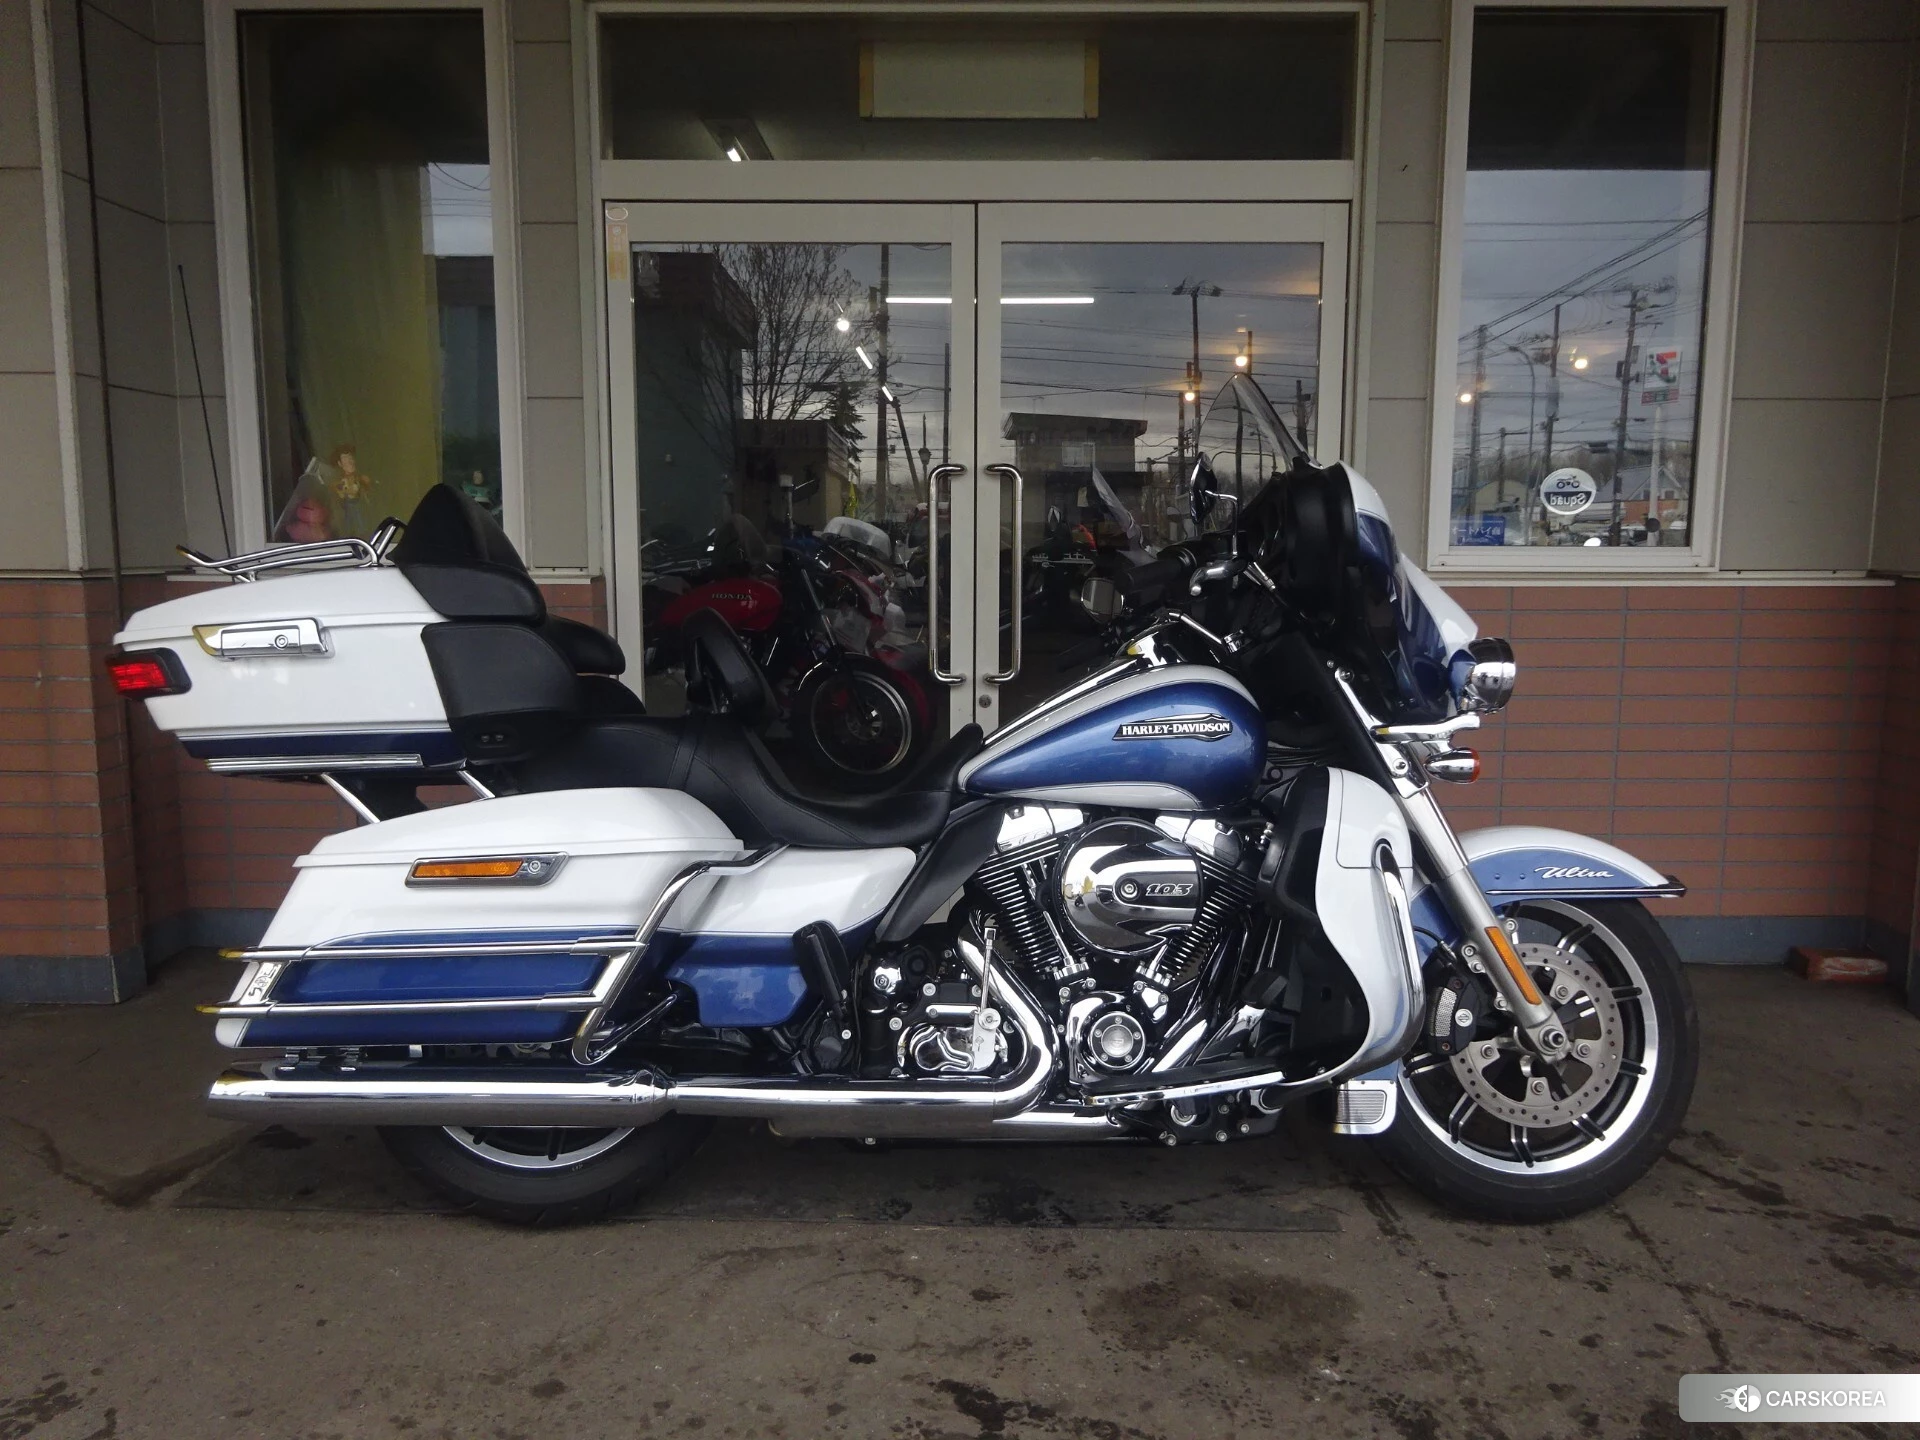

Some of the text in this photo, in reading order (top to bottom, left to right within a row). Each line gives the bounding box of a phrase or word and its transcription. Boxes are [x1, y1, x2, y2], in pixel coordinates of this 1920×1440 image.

[711, 592, 753, 601] HONDA
[1122, 722, 1230, 736] HARLEY-DAVIDSON
[1534, 866, 1615, 879] Ultra
[1145, 883, 1194, 897] 103
